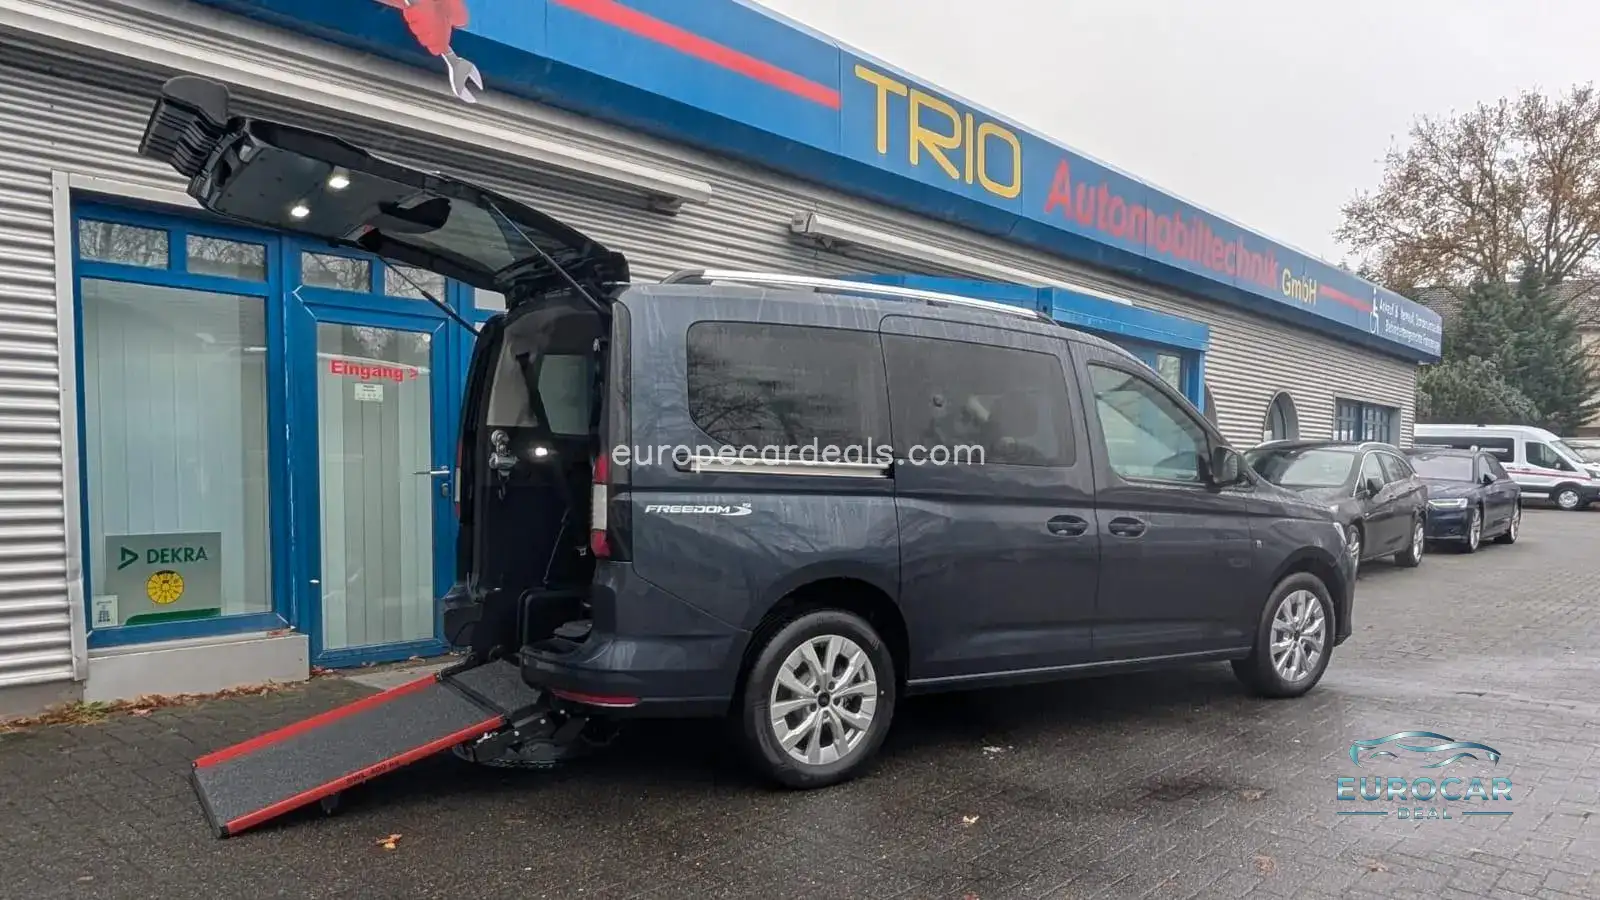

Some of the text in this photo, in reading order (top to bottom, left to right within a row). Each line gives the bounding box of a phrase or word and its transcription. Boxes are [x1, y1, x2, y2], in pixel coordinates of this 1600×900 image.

[855, 64, 1317, 306] TRIO Automobiltechnik GmbH
[330, 359, 404, 382] Eingang
[645, 504, 730, 514] FREEDOM
[146, 546, 208, 564] DEKRA
